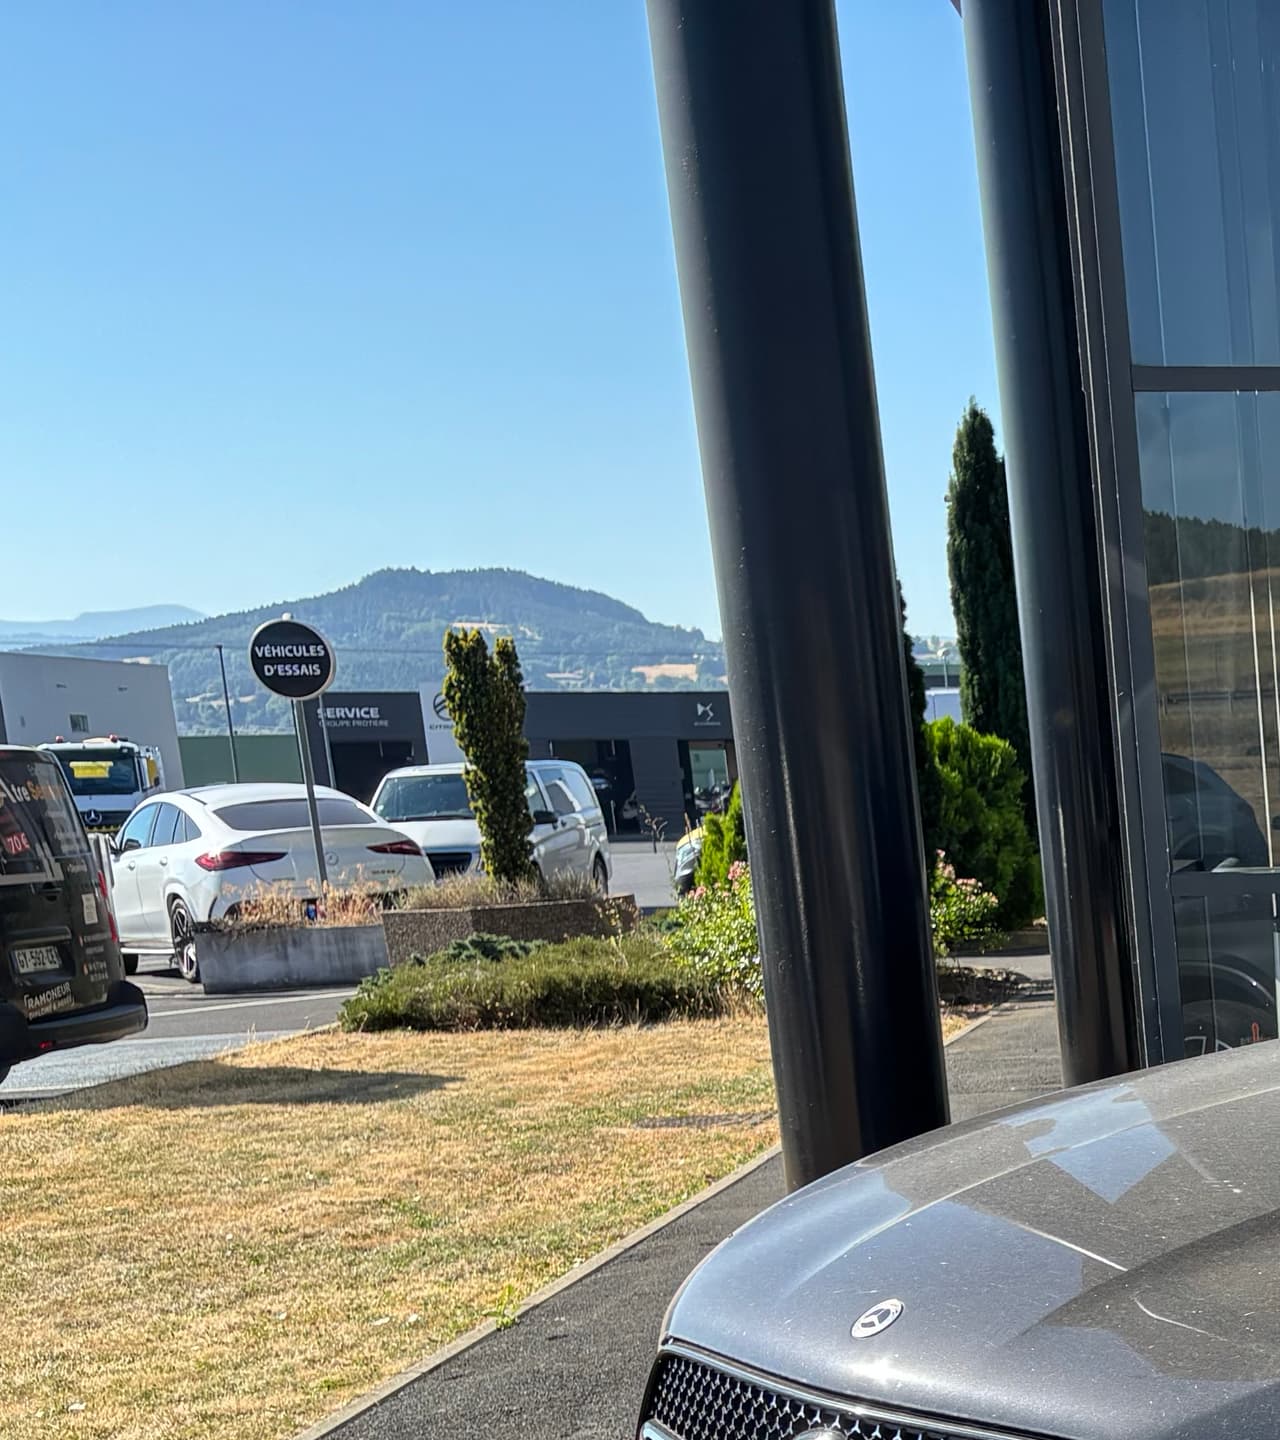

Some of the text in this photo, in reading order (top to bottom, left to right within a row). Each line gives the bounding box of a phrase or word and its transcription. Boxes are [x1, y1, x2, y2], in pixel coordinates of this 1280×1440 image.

[254, 643, 325, 658] VÉHICULES
[263, 663, 321, 676] D'ESSAIS
[316, 706, 380, 719] SERVICE
